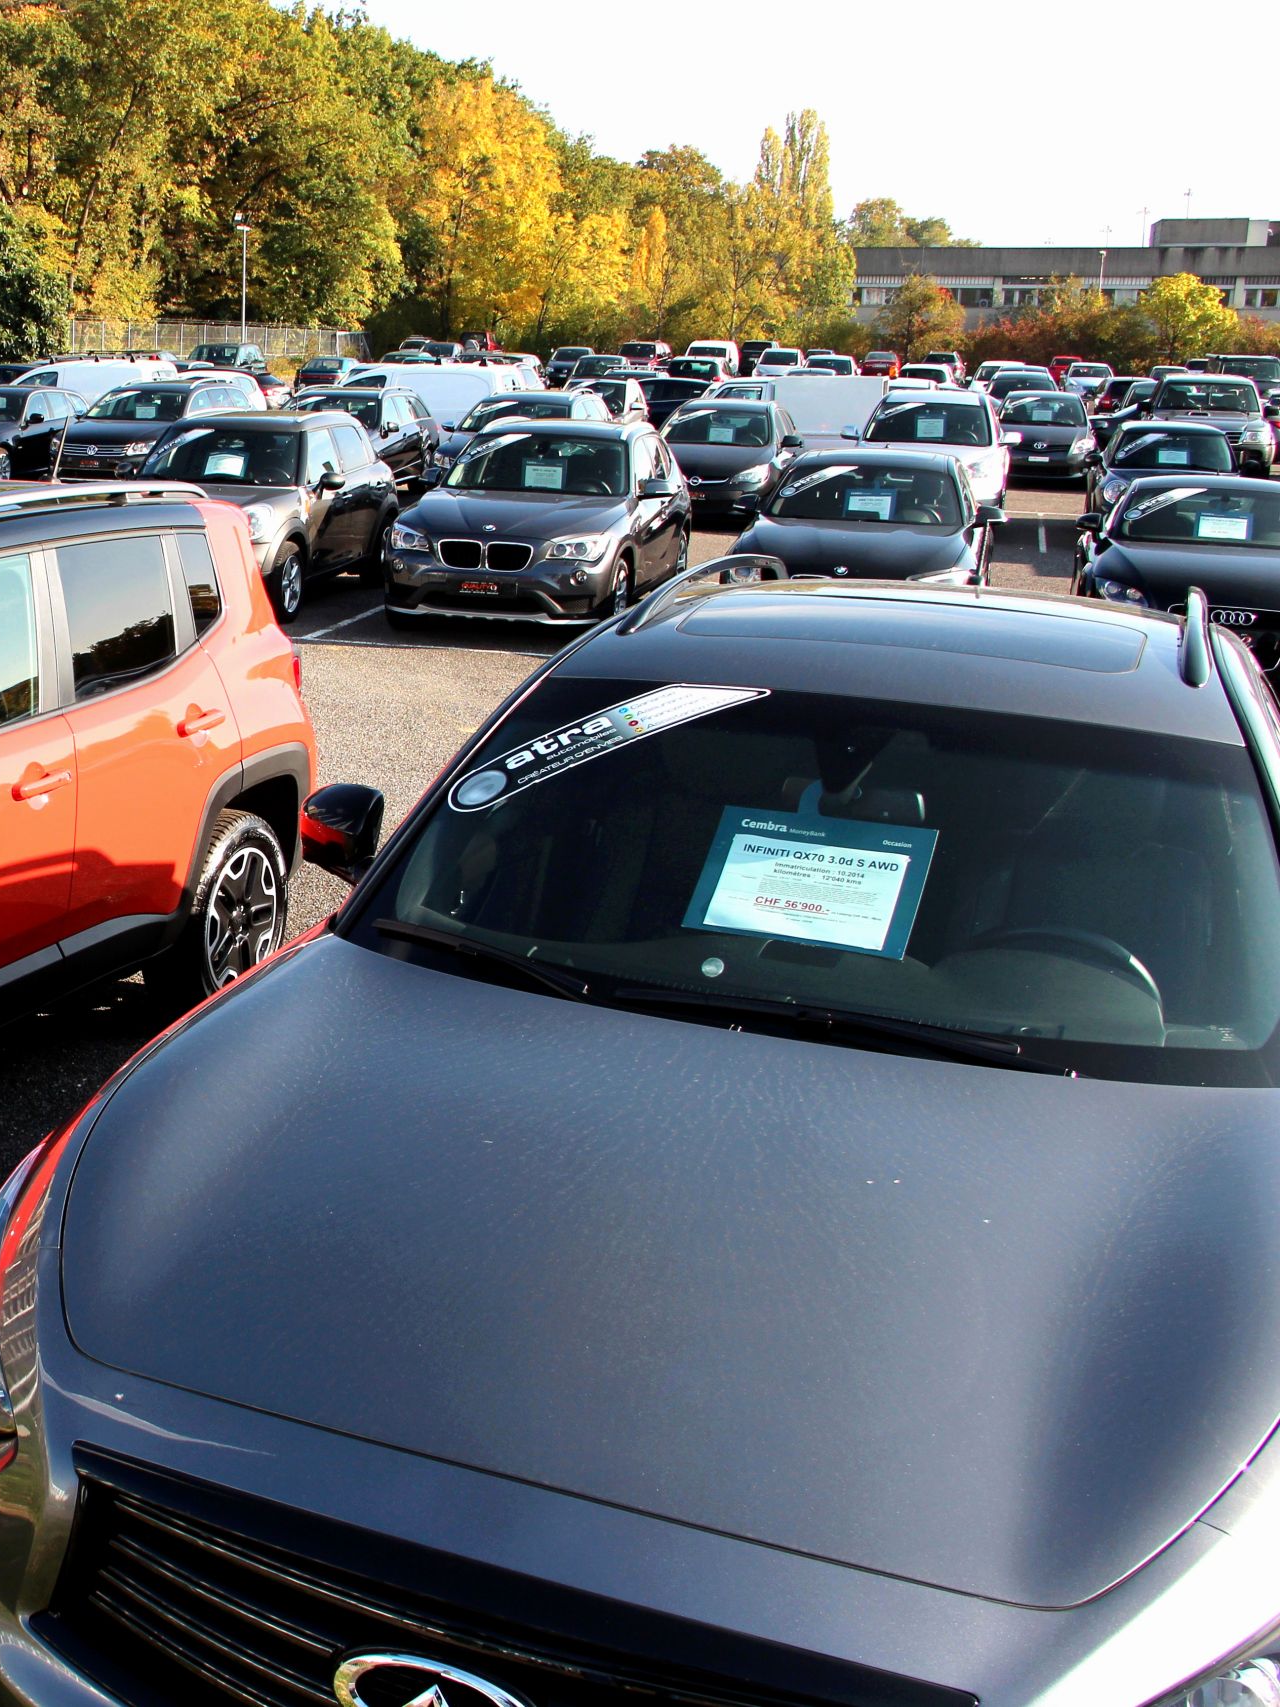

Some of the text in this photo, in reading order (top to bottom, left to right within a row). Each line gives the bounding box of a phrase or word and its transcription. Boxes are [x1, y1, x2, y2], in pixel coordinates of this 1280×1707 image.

[505, 716, 614, 770] atra
[546, 728, 617, 760] automobiles
[741, 818, 826, 838] Cembra MoneyBank
[882, 839, 913, 849] Occasion
[743, 843, 899, 872] INFINITI QX70 3.0d S AWD
[775, 862, 831, 875] Immatriculation
[837, 870, 865, 879] 10.2014
[755, 896, 831, 913] CHF 56'900.-
